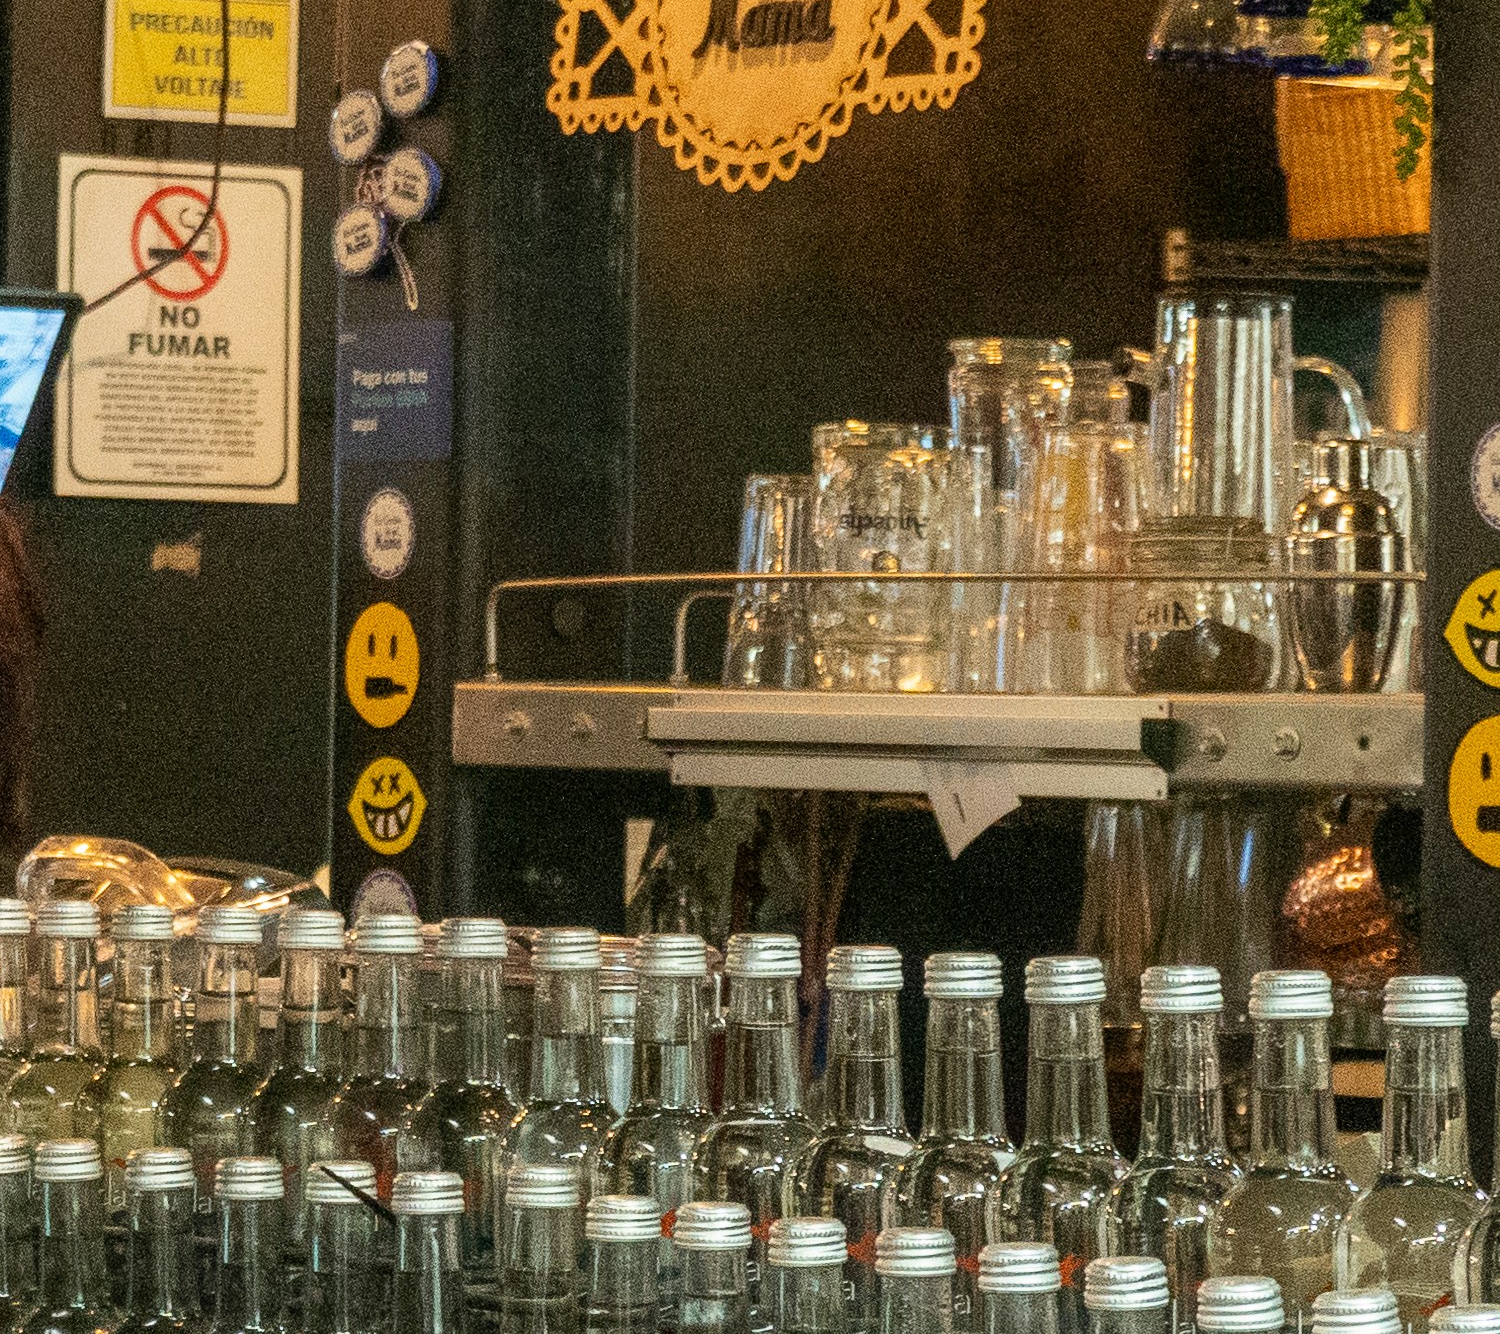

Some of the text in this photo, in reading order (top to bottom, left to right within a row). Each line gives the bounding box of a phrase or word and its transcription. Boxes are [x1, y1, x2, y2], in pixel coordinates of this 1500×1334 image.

[153, 76, 247, 101] VOLTAE
[159, 305, 201, 329] NO
[128, 332, 231, 358] FUMAR
